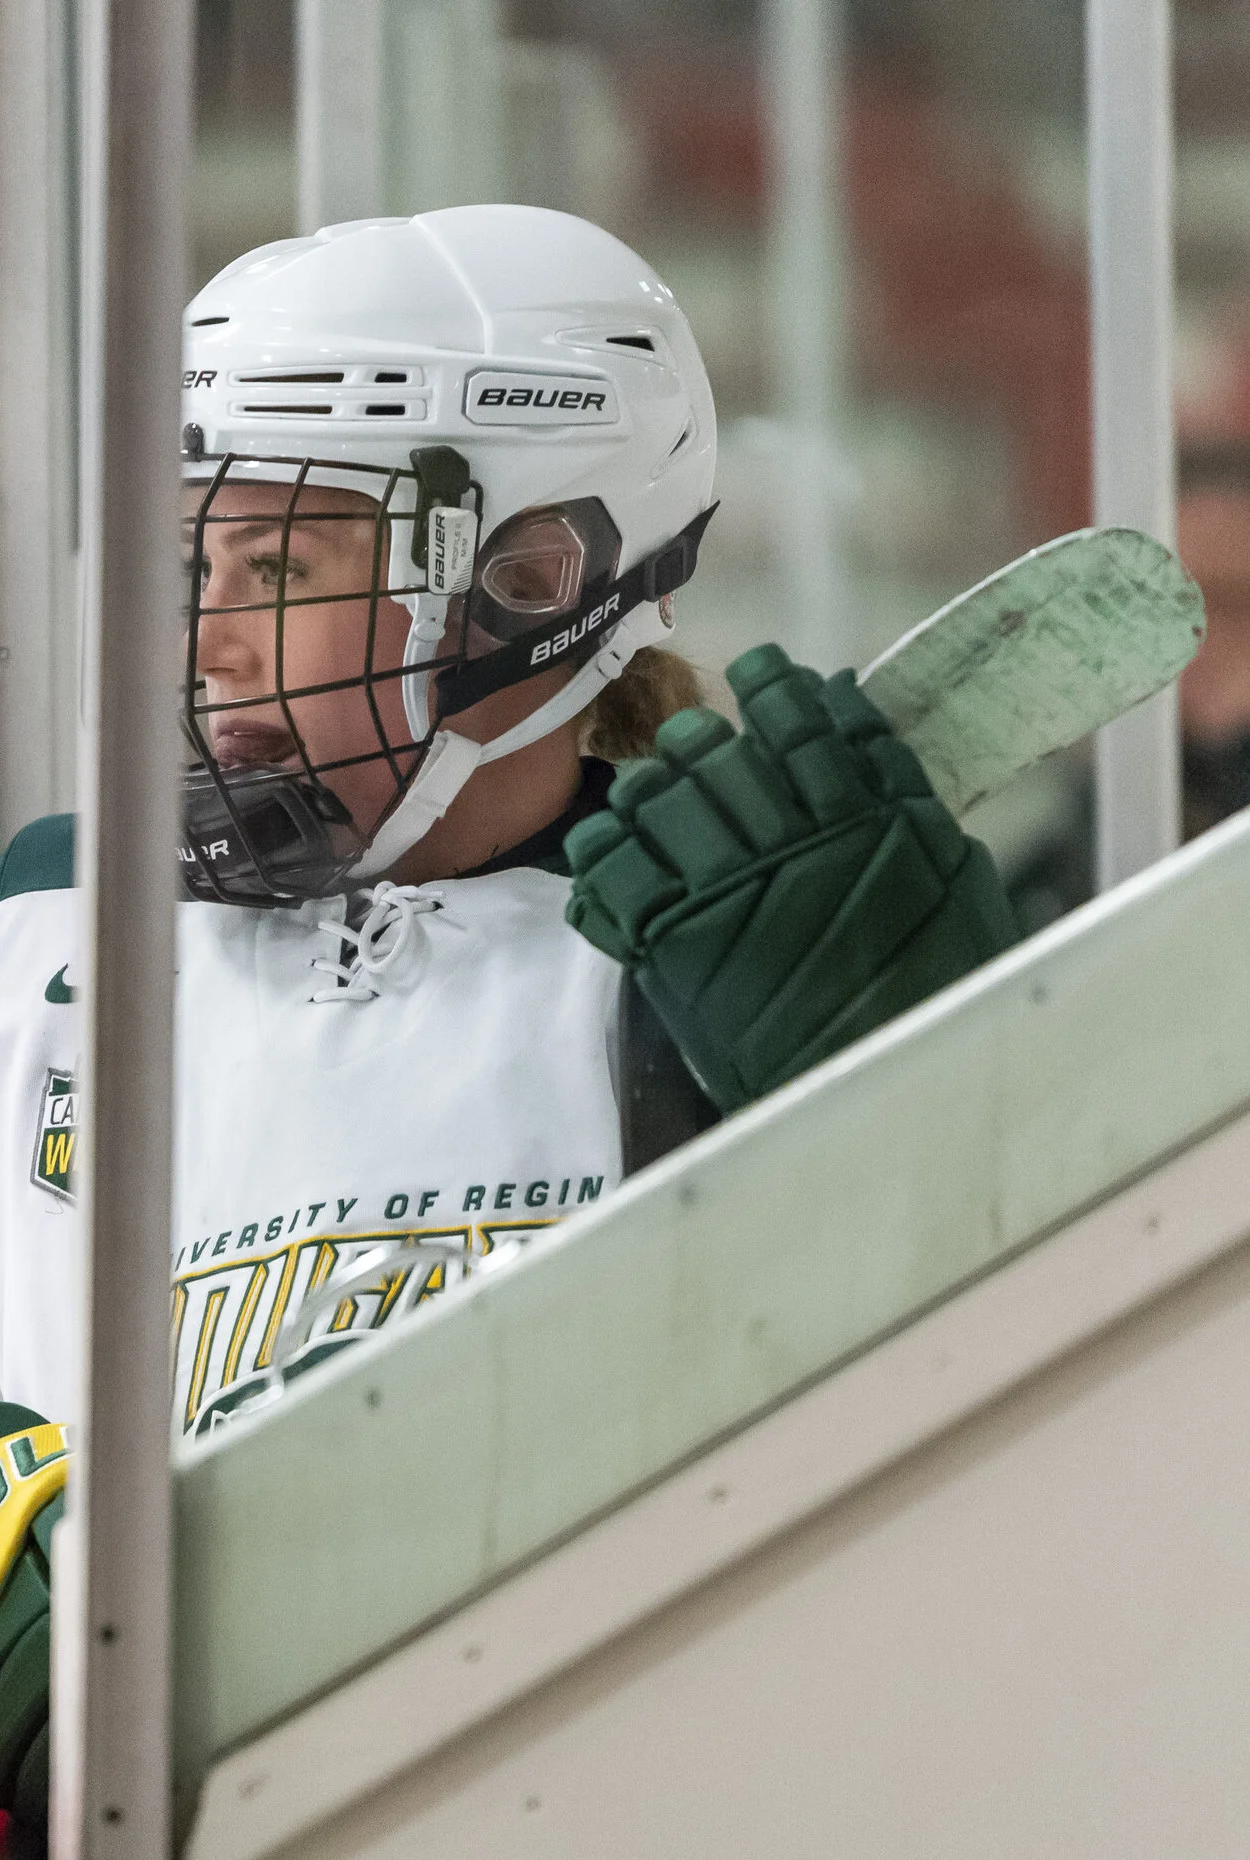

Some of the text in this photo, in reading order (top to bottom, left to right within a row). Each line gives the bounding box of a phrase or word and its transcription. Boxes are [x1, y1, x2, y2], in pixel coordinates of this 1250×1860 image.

[476, 387, 607, 412] BAUER
[434, 513, 446, 590] BAUER
[529, 592, 621, 666] BAUER
[174, 1174, 606, 1272] IVERSITY OF REGIN
